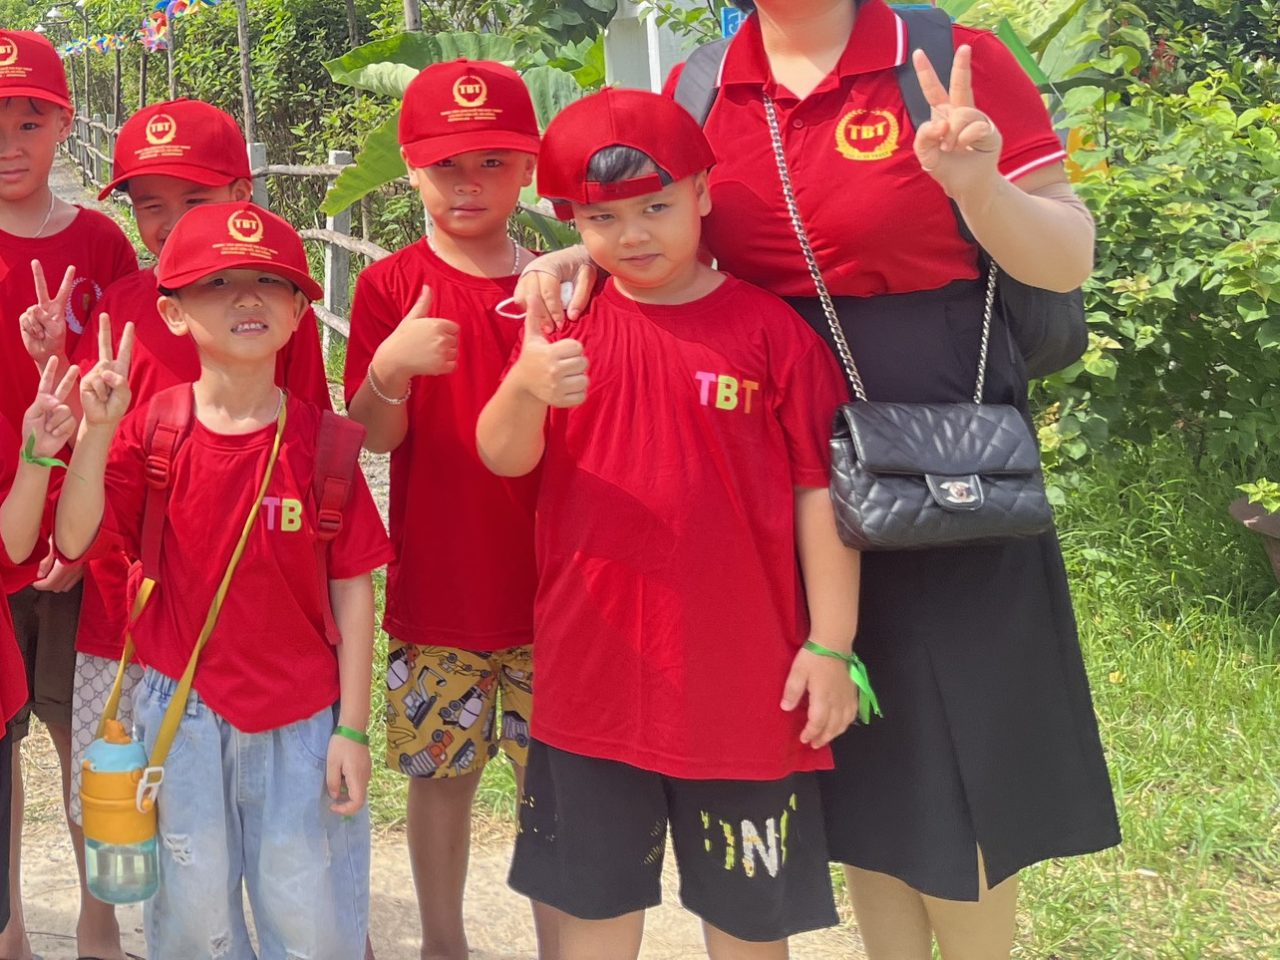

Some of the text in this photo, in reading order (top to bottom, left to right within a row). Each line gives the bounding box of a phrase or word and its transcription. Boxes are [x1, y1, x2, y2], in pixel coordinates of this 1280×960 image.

[847, 121, 887, 140] TBT
[695, 370, 760, 414] TBT
[261, 496, 302, 532] TB
